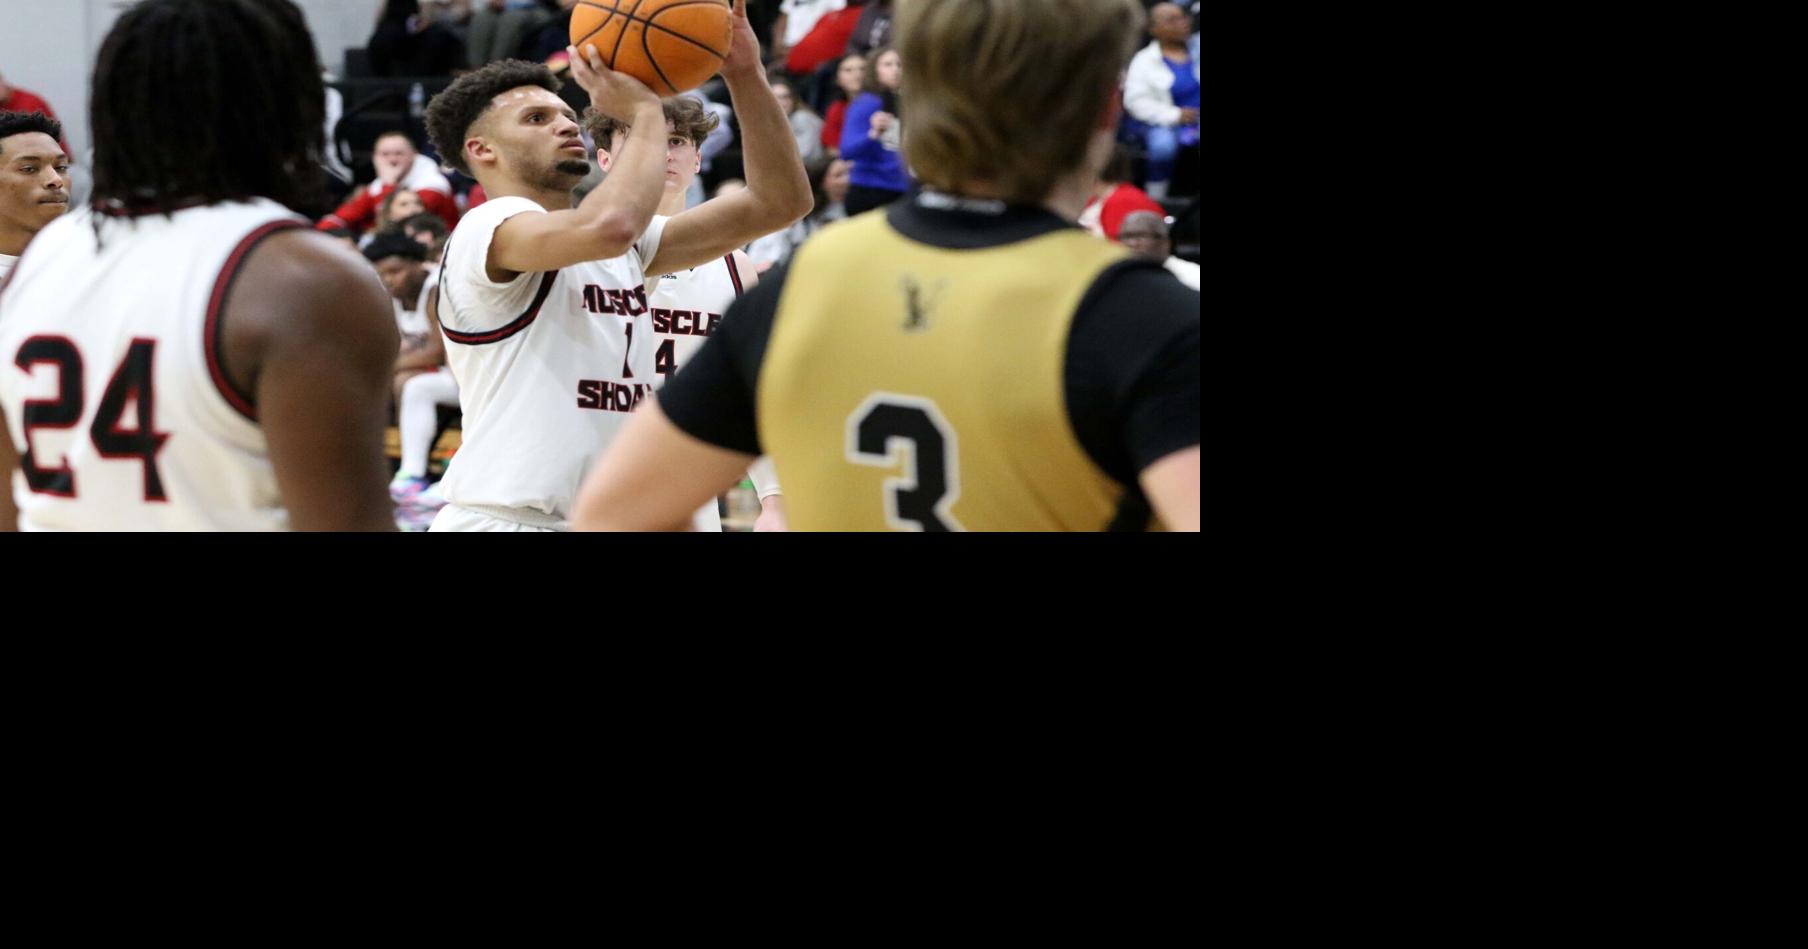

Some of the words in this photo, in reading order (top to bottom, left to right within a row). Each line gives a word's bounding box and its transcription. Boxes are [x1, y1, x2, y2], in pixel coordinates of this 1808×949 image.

[651, 308, 722, 336] SCLE
[622, 322, 634, 378] 1
[655, 339, 678, 376] 4
[14, 333, 172, 502] 24
[577, 379, 652, 412] SHOA
[845, 391, 966, 532] 3
